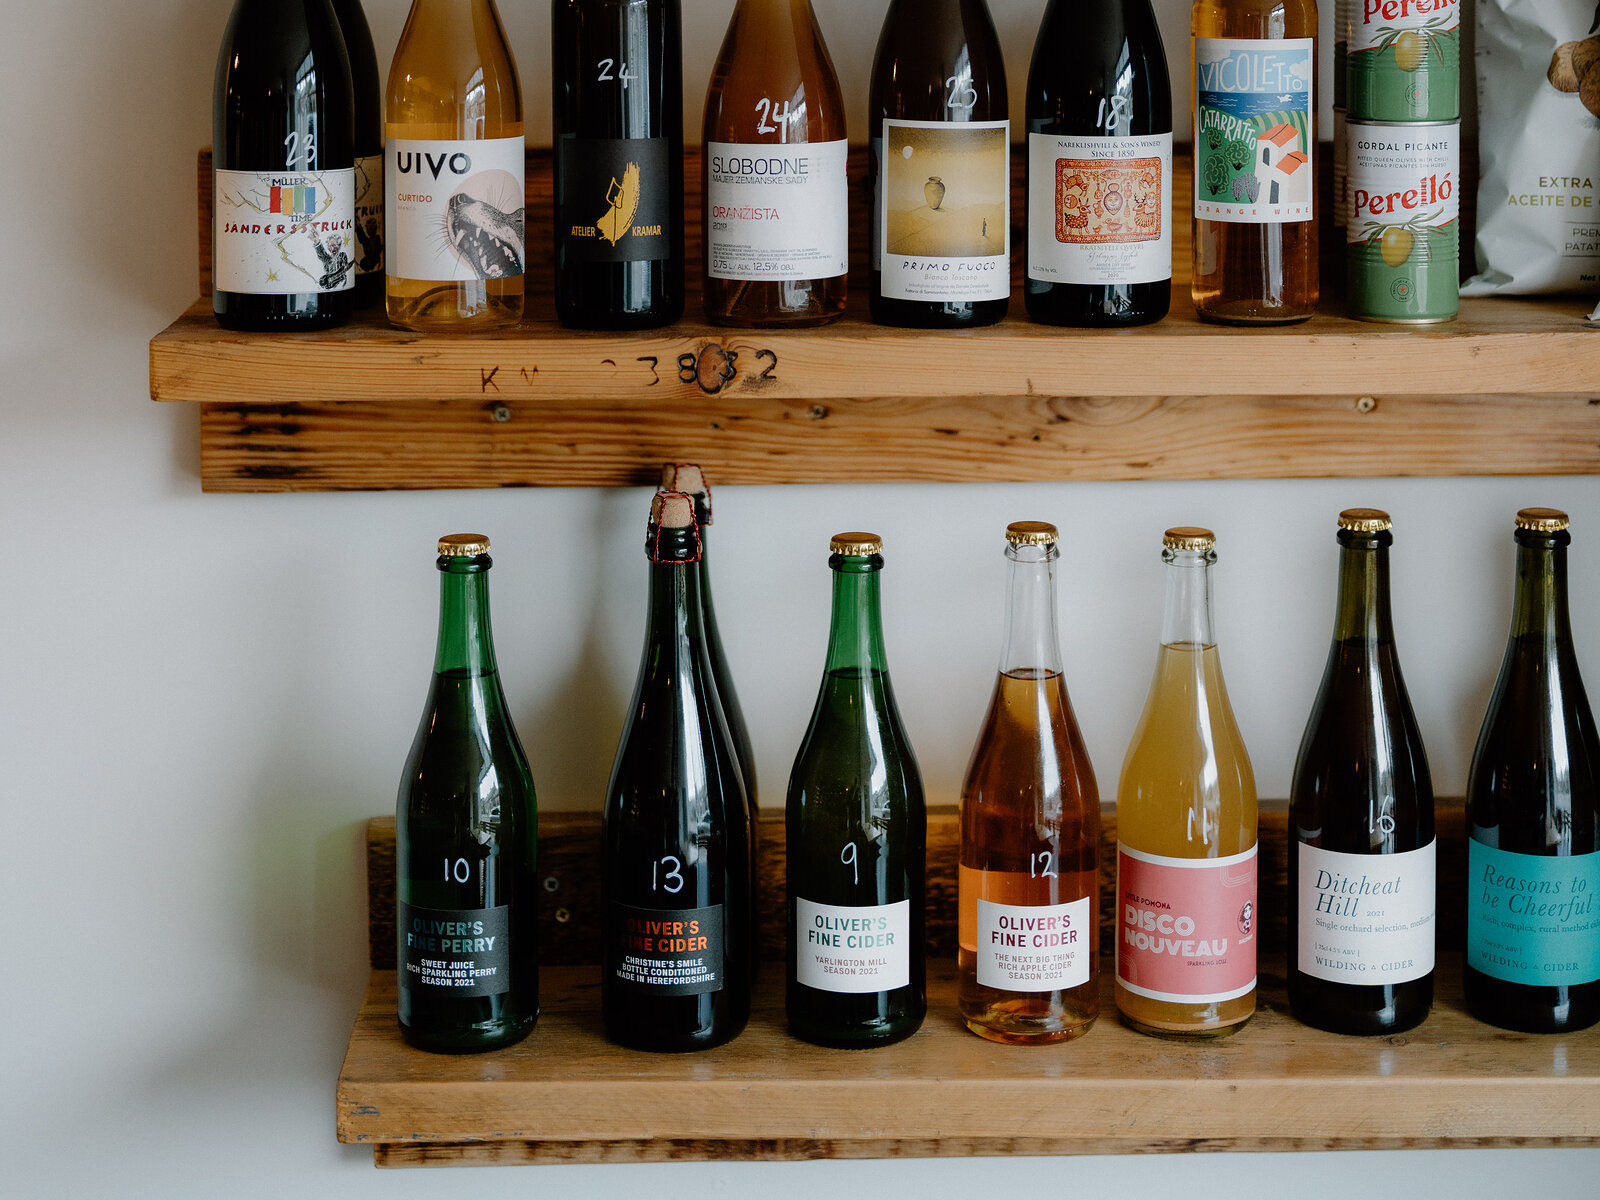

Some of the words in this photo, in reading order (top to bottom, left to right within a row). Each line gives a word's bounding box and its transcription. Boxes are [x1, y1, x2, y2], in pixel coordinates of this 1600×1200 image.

[597, 58, 638, 89] 24
[1200, 53, 1303, 92] VICOLETTO
[945, 76, 978, 110] 25
[755, 97, 791, 144] 24
[1096, 95, 1129, 130] 18
[1199, 105, 1258, 150] CATARRATTO
[284, 131, 317, 166] 23
[1091, 150, 1115, 158] SINCE
[1117, 150, 1135, 158] 1850
[1357, 141, 1399, 151] GORDAL
[1405, 141, 1448, 151] PICANTE
[397, 151, 472, 181] UIVO
[712, 156, 809, 175] SLOBODNE
[272, 176, 309, 186] MÜLLER
[712, 175, 735, 185] MAJER
[735, 175, 784, 185] ZEMIANSKE
[785, 175, 809, 185] SADY
[1539, 177, 1593, 189] EXTRA
[398, 193, 433, 203] CURTIDO
[1354, 172, 1452, 218] Perelló
[1508, 194, 1565, 207] ACEITE
[1571, 195, 1592, 207] DE
[288, 213, 313, 222] TIME
[712, 204, 779, 220] ORANŽISTA
[1198, 205, 1257, 215] ORANGE
[1274, 205, 1309, 215] WINE
[571, 225, 596, 237] ATELIER
[632, 224, 662, 236] KRAMAR
[902, 261, 950, 271] PRIMO
[958, 261, 996, 271] FUOCO
[444, 857, 470, 883] 10
[841, 842, 859, 886] 9
[1031, 851, 1058, 879] 12
[652, 855, 684, 893] 13
[1314, 869, 1401, 895] Ditcheat
[1482, 864, 1562, 894] Reasons
[1571, 876, 1587, 893] to
[1140, 897, 1171, 910] POMONA
[1315, 893, 1359, 917] Hill
[1482, 886, 1500, 909] be
[1509, 893, 1592, 922] Cheerful
[413, 917, 484, 936] OLIVER'S
[627, 917, 700, 936] OLIVER'S
[815, 915, 888, 932] OLIVER'S
[999, 915, 1071, 931] OLIVER'S
[1125, 903, 1195, 937] DISCO
[1315, 918, 1338, 931] Single
[1340, 924, 1372, 933] orchard
[1374, 923, 1409, 933] selection,
[1501, 919, 1536, 933] complex,
[1539, 924, 1560, 933] rural
[1562, 921, 1589, 932] method
[407, 932, 436, 951] FINE
[441, 936, 496, 953] PERRY
[621, 933, 654, 951] FINE
[658, 936, 708, 953] CIDER
[808, 930, 841, 948] FINE
[847, 932, 895, 949] CIDER
[991, 931, 1026, 948] FINE
[1032, 930, 1078, 948] CIDER
[1125, 927, 1228, 957] NOUVEAU
[421, 958, 447, 969] SWEET
[448, 961, 475, 969] JUICE
[625, 955, 675, 968] CHRISTINE'S
[677, 958, 703, 968] SMILE
[815, 955, 865, 967] YARLINGTON
[868, 958, 888, 967] MILL
[994, 952, 1009, 962] THE
[1011, 955, 1033, 963] NEXT
[1036, 955, 1050, 963] BIG
[1053, 952, 1075, 962] THING
[1315, 956, 1366, 972] WILDING
[1381, 959, 1414, 972] CIDER
[1481, 950, 1528, 970] WILDING
[1543, 962, 1579, 972] CIDER
[406, 963, 420, 974] RICH
[421, 967, 467, 978] SPARKLING
[469, 967, 497, 977] PERRY
[622, 963, 649, 975] BOTTLE
[650, 966, 707, 977] CONDITIONED
[823, 965, 856, 976] SEASON
[859, 967, 879, 976] 2021
[998, 962, 1018, 971] RICH
[1021, 963, 1047, 972] APPLE
[1049, 961, 1072, 971] CIDER
[421, 976, 453, 986] SEASON
[616, 969, 635, 981] MADE
[636, 974, 645, 983] IN
[646, 973, 716, 985] HEREFORDSHIRE
[1008, 971, 1042, 980] SEASON
[1044, 971, 1063, 980] 2021
